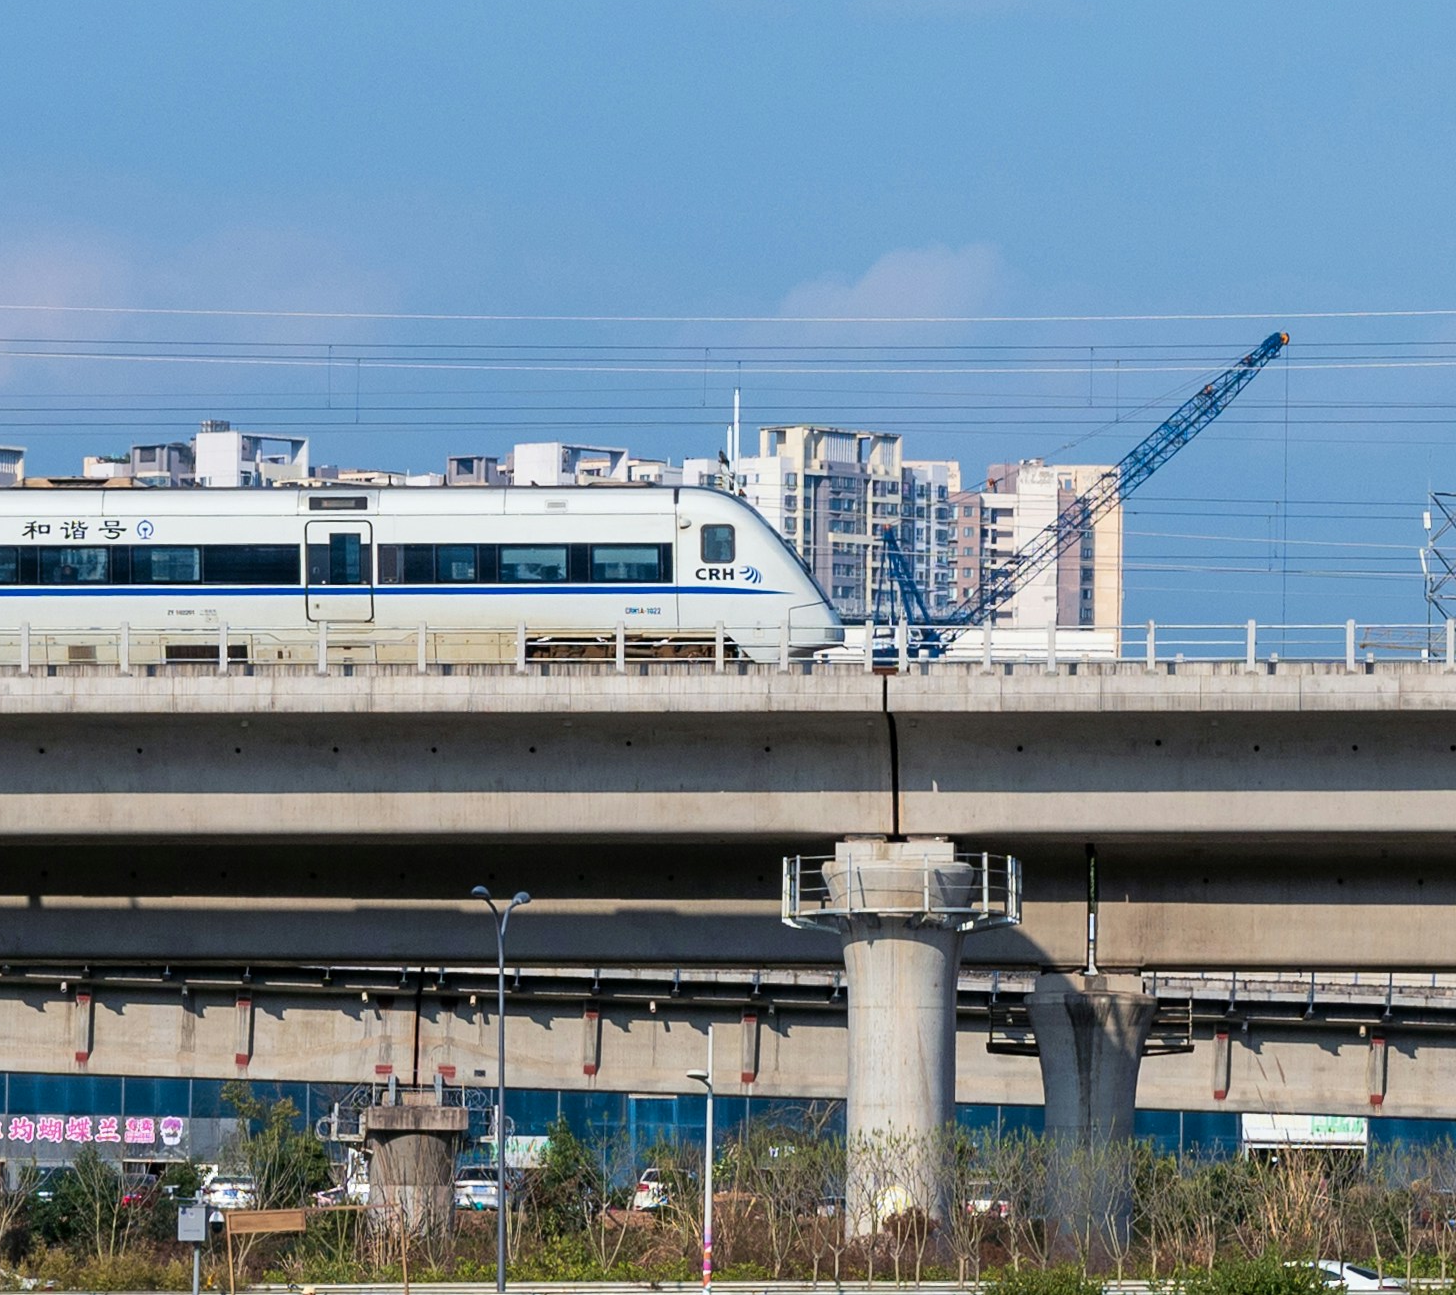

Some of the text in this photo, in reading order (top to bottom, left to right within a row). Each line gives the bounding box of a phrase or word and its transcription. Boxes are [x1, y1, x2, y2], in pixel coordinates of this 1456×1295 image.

[22, 520, 127, 539] 和谐号
[695, 568, 735, 581] CRH
